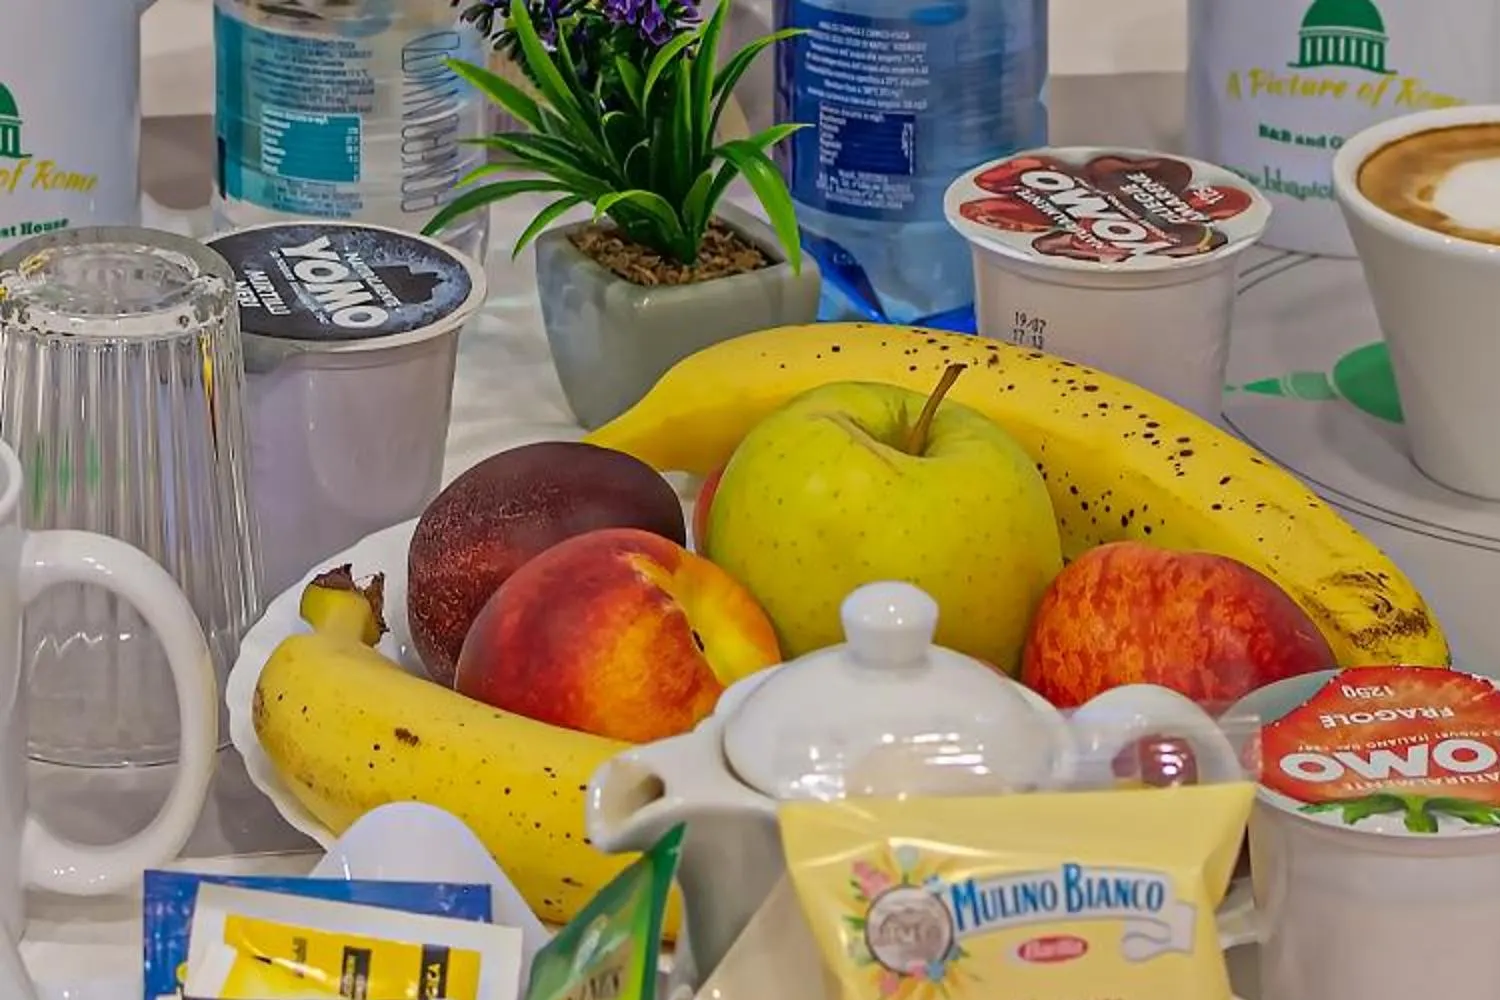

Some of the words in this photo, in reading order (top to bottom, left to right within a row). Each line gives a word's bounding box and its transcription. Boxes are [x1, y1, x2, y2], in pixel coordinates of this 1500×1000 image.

[1227, 70, 1242, 99] A
[1248, 67, 1348, 98] Picture
[1356, 73, 1397, 107] of
[1258, 123, 1292, 144] B&B
[1295, 135, 1327, 149] and
[1020, 169, 1176, 252] YOMO
[280, 235, 389, 329] YOMO
[1341, 683, 1396, 700] 125g
[1318, 706, 1457, 730] FRAGOLE
[1365, 734, 1431, 749] ITALIANO
[951, 878, 1059, 932] MULINO
[1061, 863, 1165, 914] BIANCO
